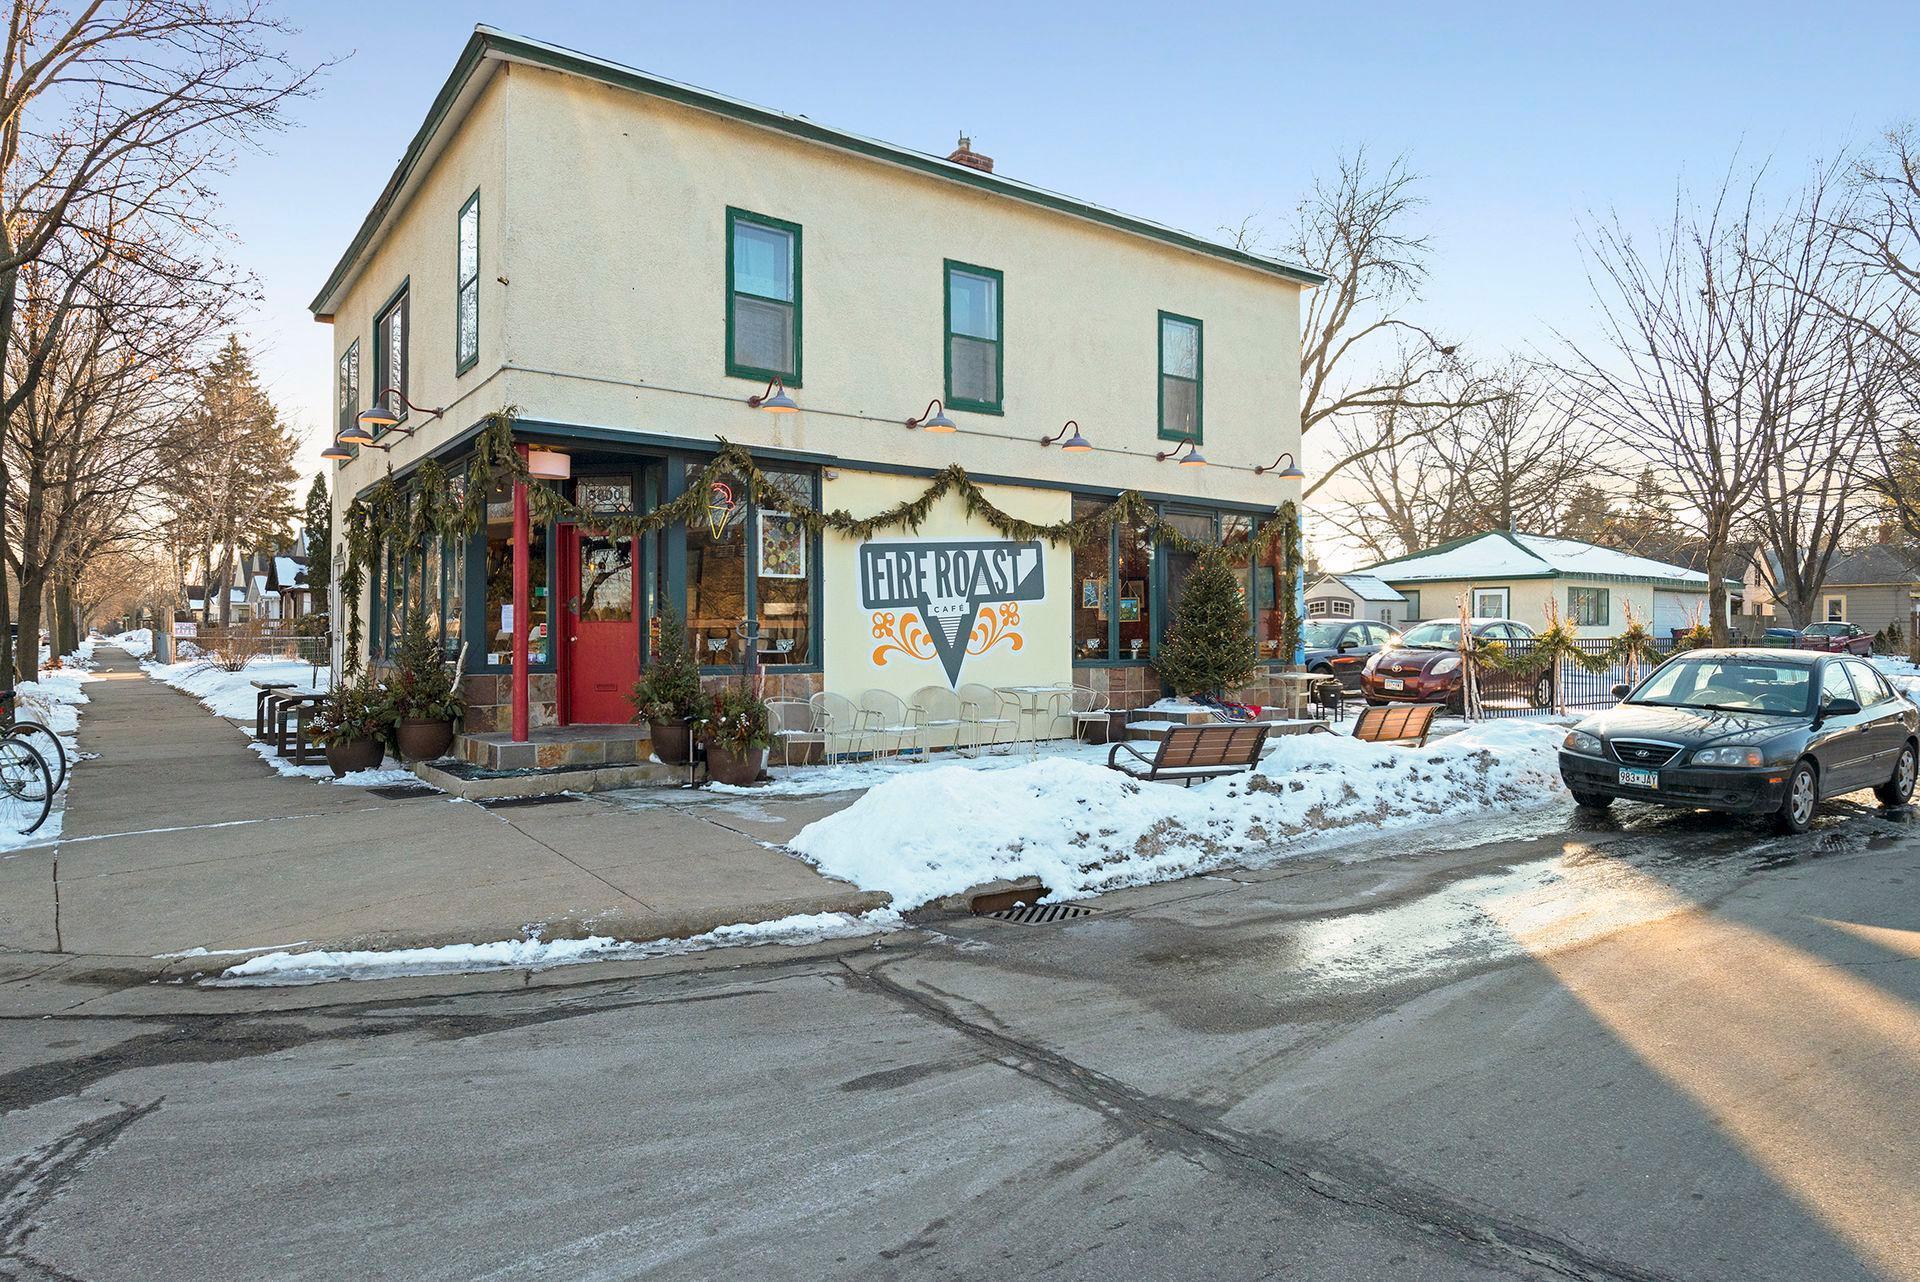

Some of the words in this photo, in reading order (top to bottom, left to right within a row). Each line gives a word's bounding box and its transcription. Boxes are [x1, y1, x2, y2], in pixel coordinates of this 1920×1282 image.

[871, 550, 927, 601] FIRE
[935, 548, 1022, 600] ROAST
[933, 604, 964, 613] CAFÉ
